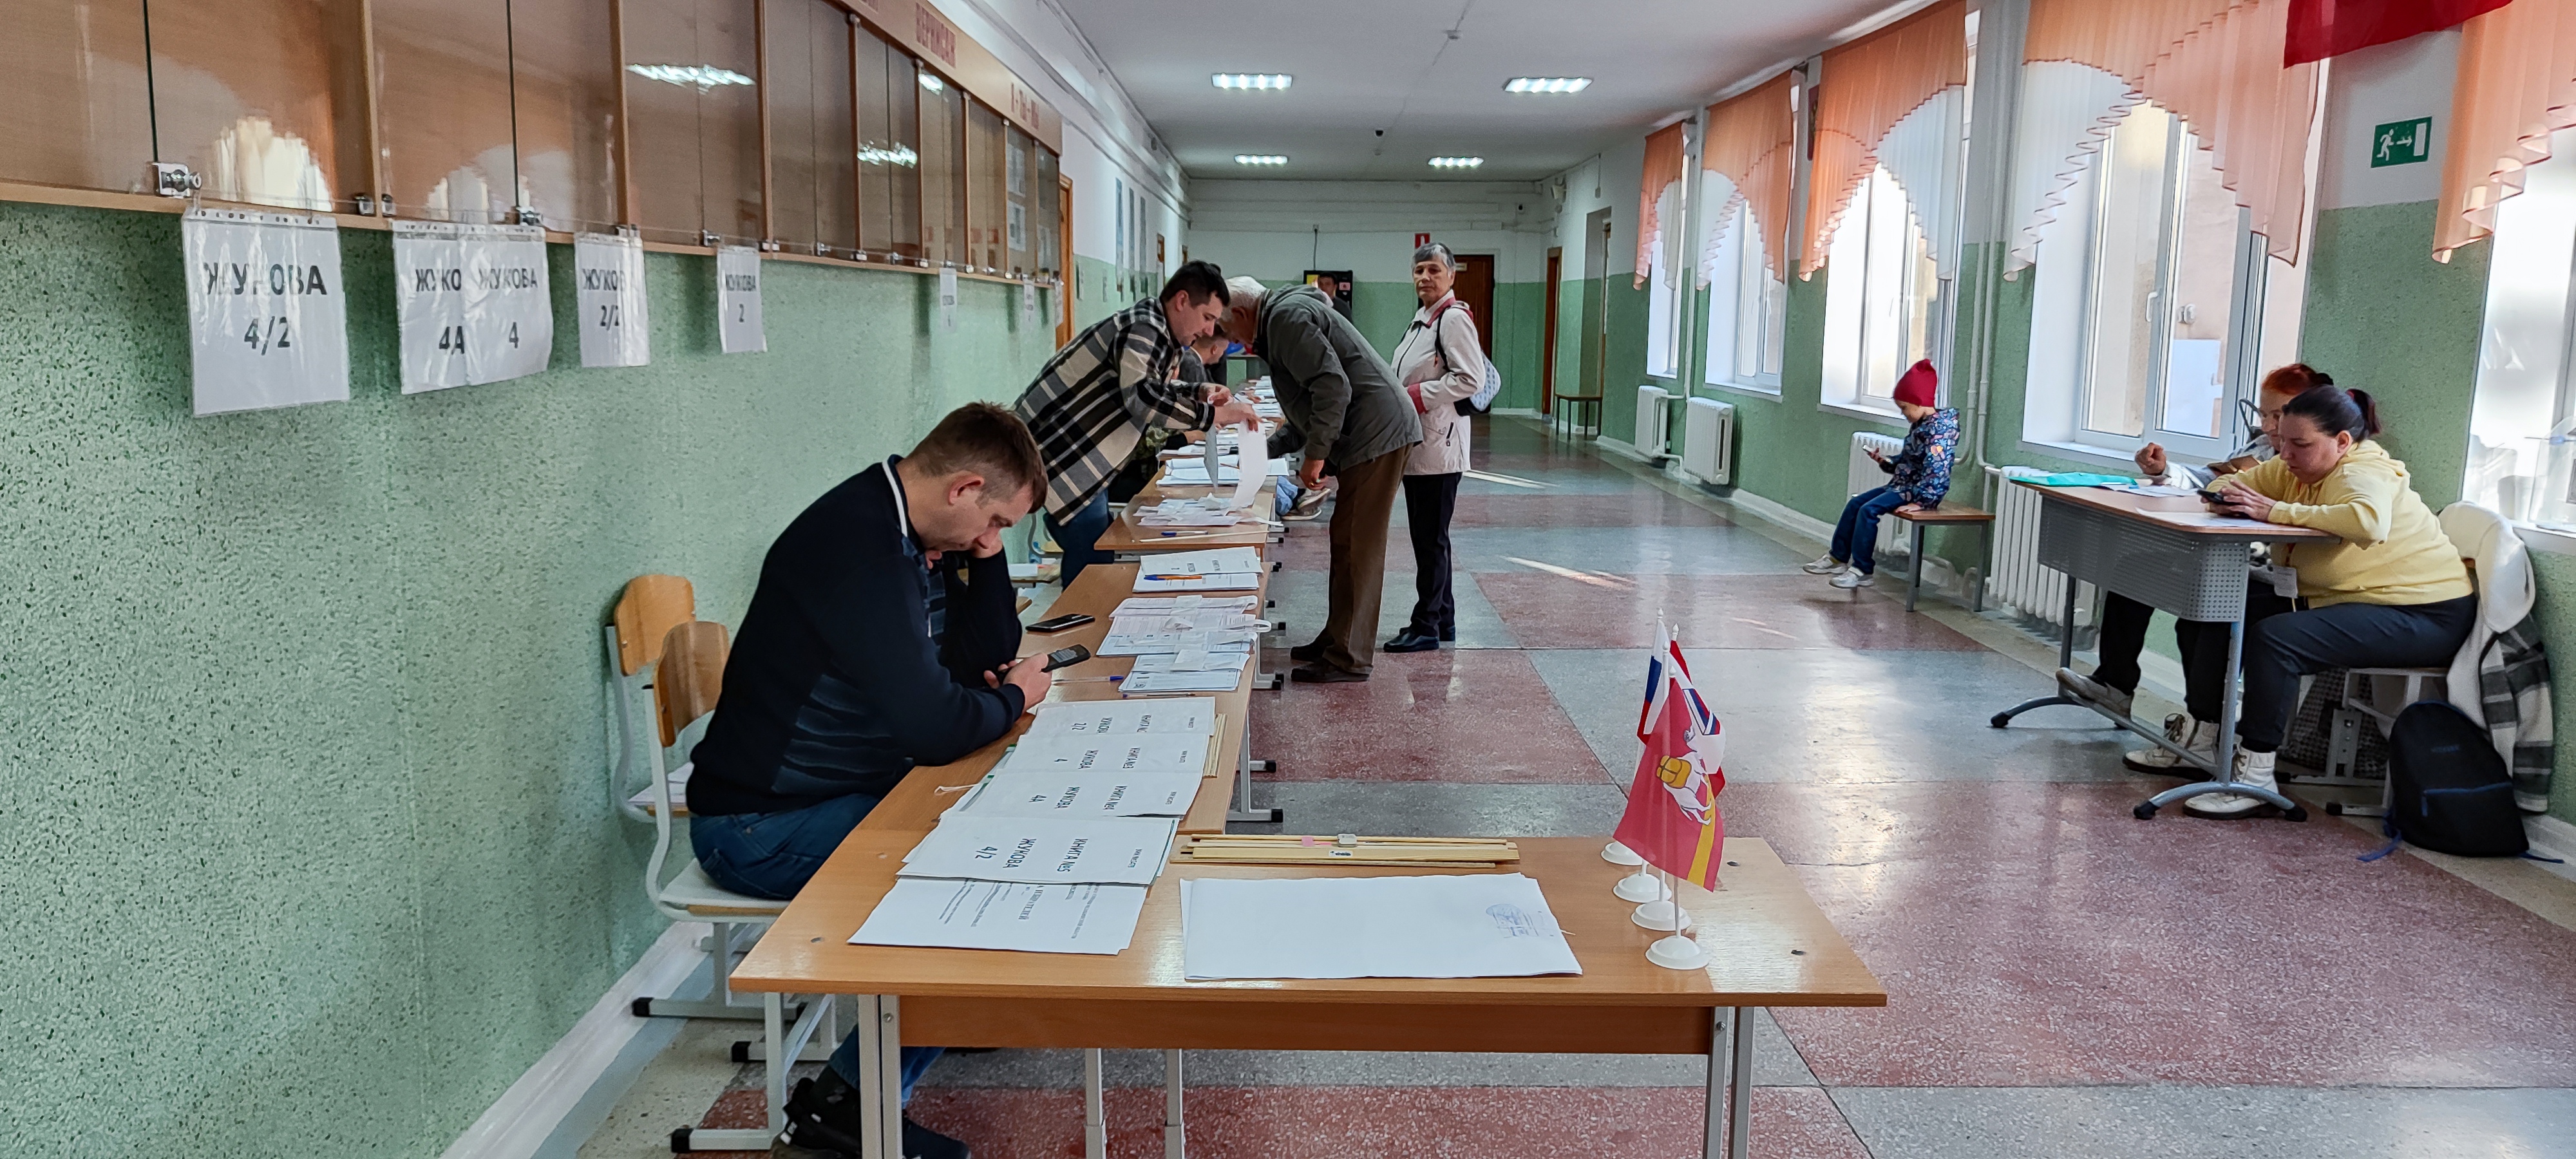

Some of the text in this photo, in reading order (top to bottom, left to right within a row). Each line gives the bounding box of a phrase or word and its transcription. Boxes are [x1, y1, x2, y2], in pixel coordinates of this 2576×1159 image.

[203, 262, 328, 295] ЖУОВА
[415, 269, 462, 292] ЖУКО
[478, 268, 538, 290] ЖУКОВА
[739, 303, 744, 323] 2
[243, 316, 290, 356] 4/2
[439, 325, 466, 355] 4А
[509, 321, 519, 349] 4
[1078, 749, 1099, 769] ЖУКОВА
[1126, 747, 1141, 761] КНИГА
[1028, 795, 1047, 803] 4А
[1054, 786, 1081, 809] ЖУКОВА
[1102, 786, 1128, 810] КНИГА №4
[974, 846, 998, 859] 4/2
[1002, 838, 1037, 869] ЖУКОВА
[1064, 838, 1088, 860] КНИГА
[1057, 861, 1075, 872] №5
